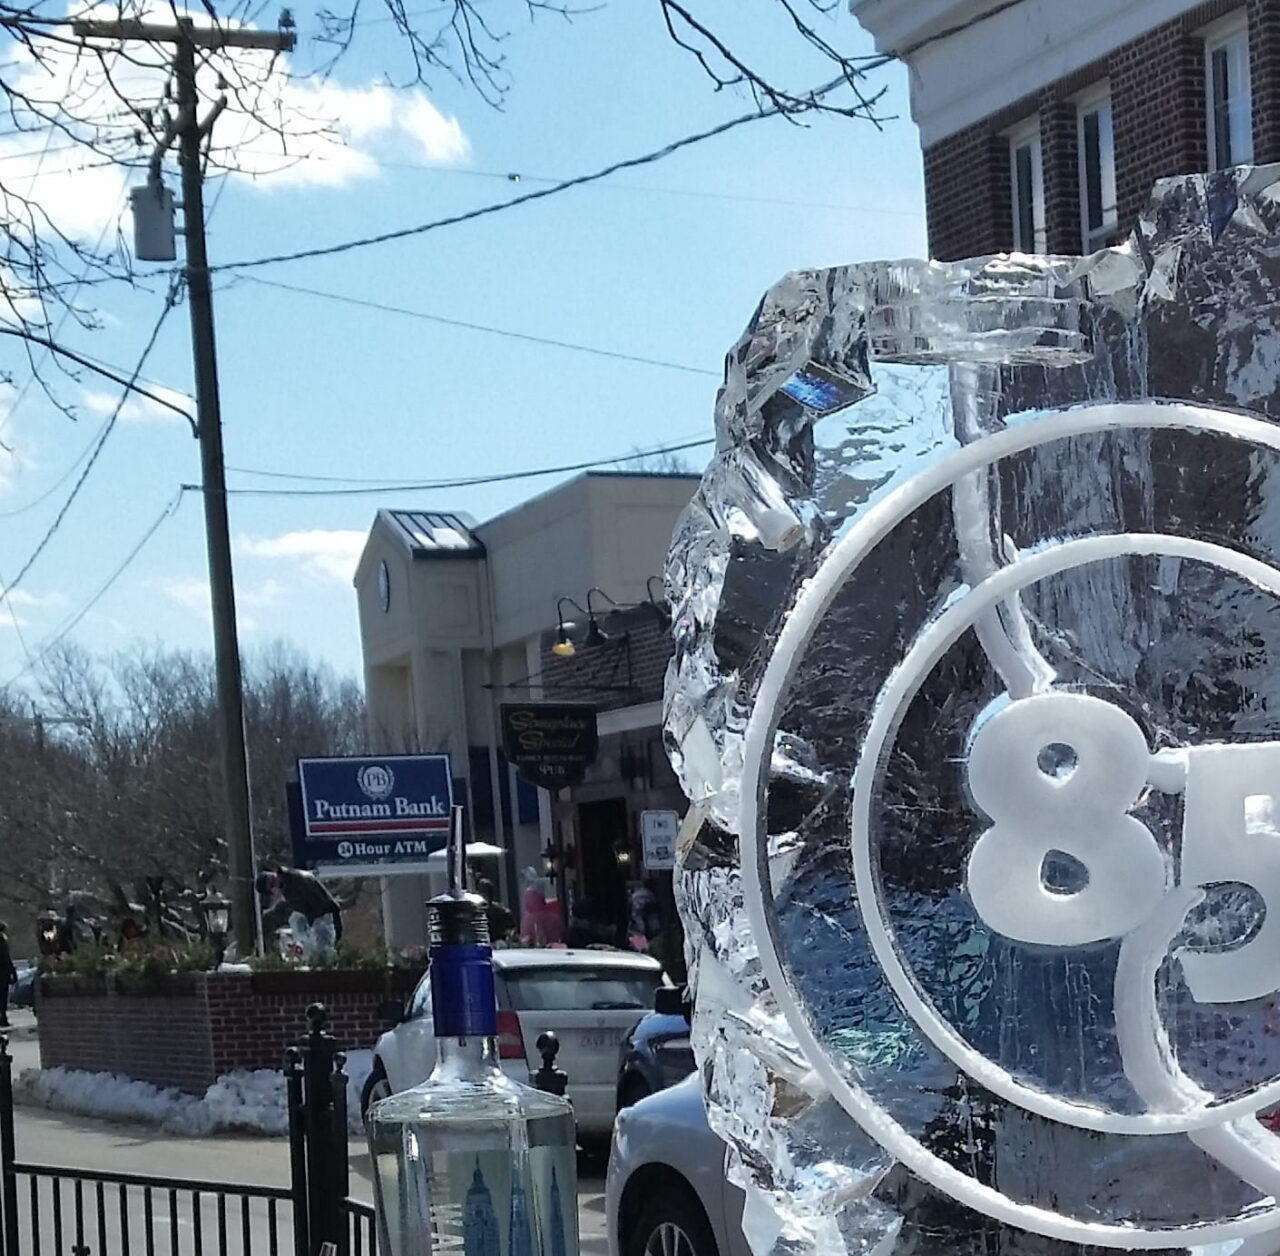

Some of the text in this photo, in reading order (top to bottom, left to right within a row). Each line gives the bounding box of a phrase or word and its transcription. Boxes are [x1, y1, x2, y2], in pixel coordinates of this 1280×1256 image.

[314, 795, 446, 818] Putnam Bank
[354, 843, 391, 855] Hour
[394, 840, 427, 853] ATM
